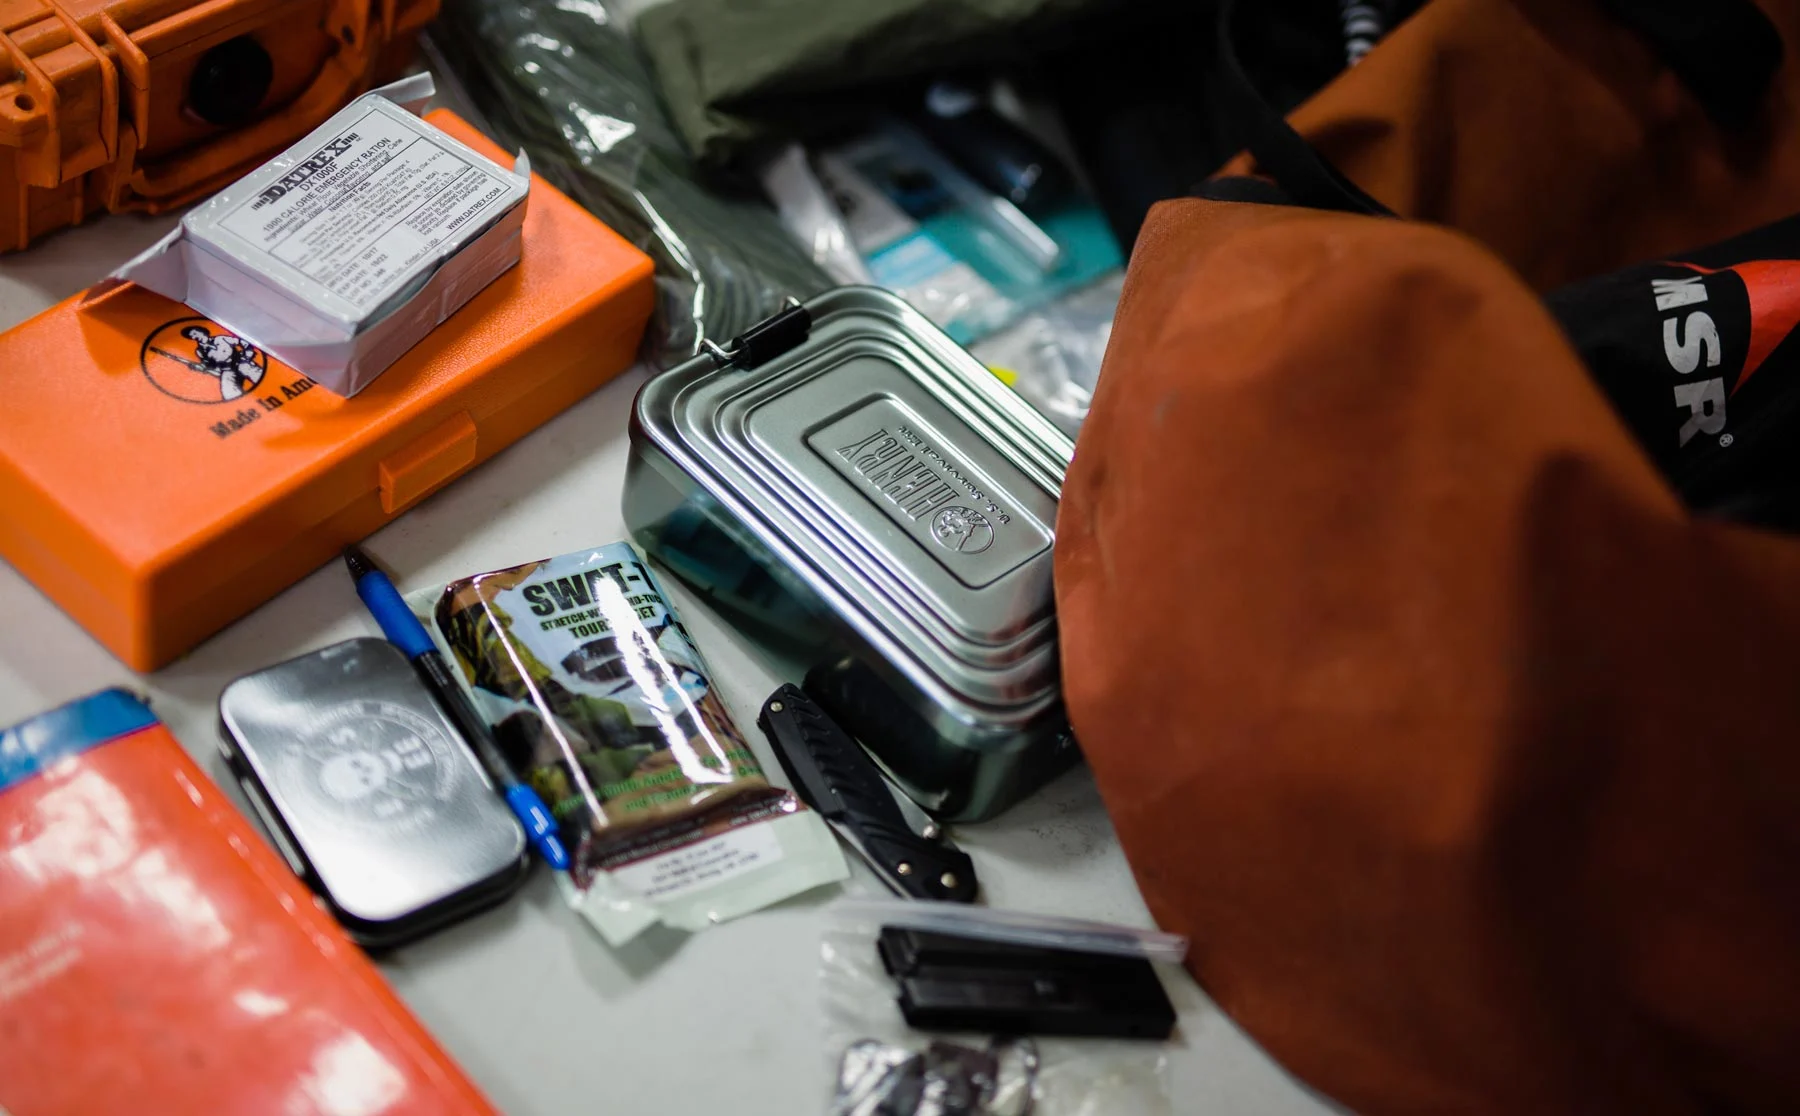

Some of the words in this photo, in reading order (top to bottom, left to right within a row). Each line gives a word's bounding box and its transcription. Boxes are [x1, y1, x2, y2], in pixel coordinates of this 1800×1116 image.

[257, 137, 352, 205] DATREX
[297, 160, 341, 192] DX1000F
[331, 168, 363, 191] Vegetable
[385, 137, 405, 150] Cane
[368, 160, 384, 172] and
[260, 215, 284, 233] 1000
[278, 190, 319, 219] CALORIE
[312, 156, 366, 194] EMERGENCY
[359, 136, 392, 160] RATION
[327, 191, 356, 213] Nutrition
[351, 179, 372, 195] Facts
[382, 201, 398, 213] Daily
[393, 186, 419, 205] Allowance
[403, 209, 427, 226] Replace
[444, 186, 503, 230] WWW.DATREX.COM
[338, 261, 361, 278] DATE
[209, 408, 261, 440] Made
[256, 395, 284, 412] In
[898, 425, 923, 448] Kit
[835, 428, 960, 521] HENRY
[920, 445, 985, 500] Survival
[986, 500, 1011, 525] U.S.
